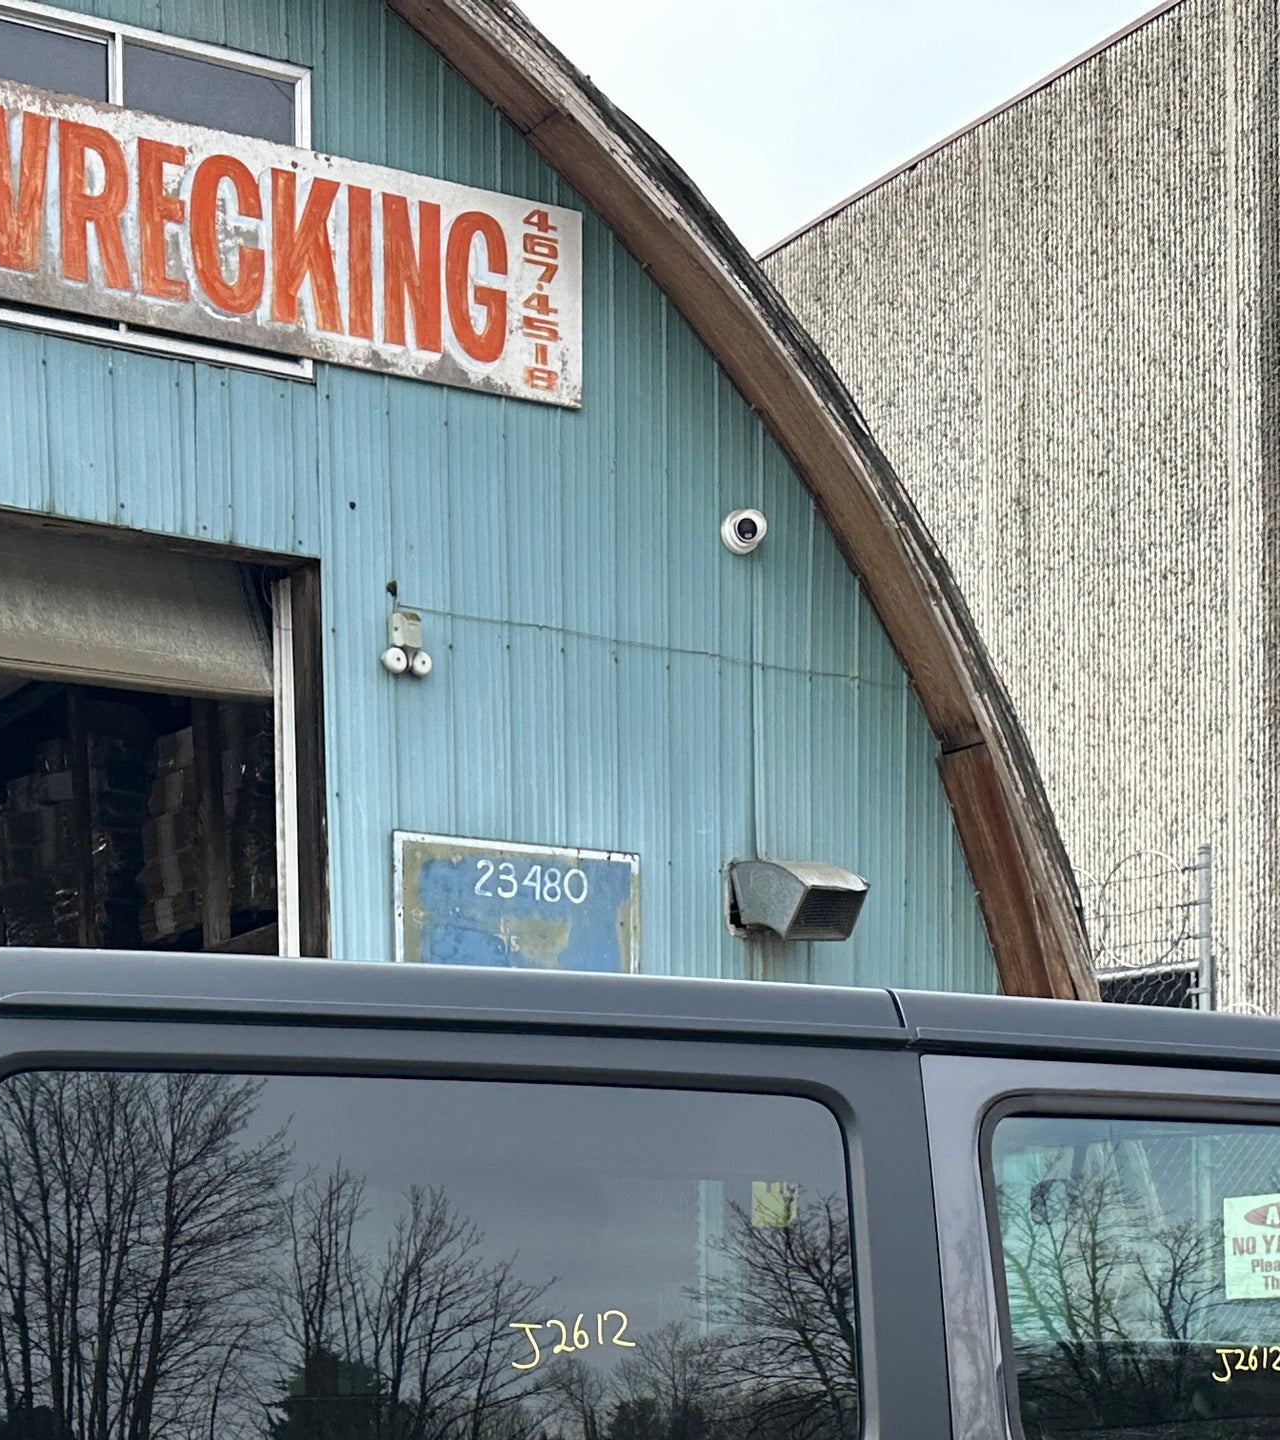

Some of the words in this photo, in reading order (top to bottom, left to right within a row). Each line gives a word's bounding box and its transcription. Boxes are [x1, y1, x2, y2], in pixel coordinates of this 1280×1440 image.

[474, 859, 589, 904] 23480
[1232, 1237, 1257, 1256] NO
[509, 1309, 636, 1370] J2612
